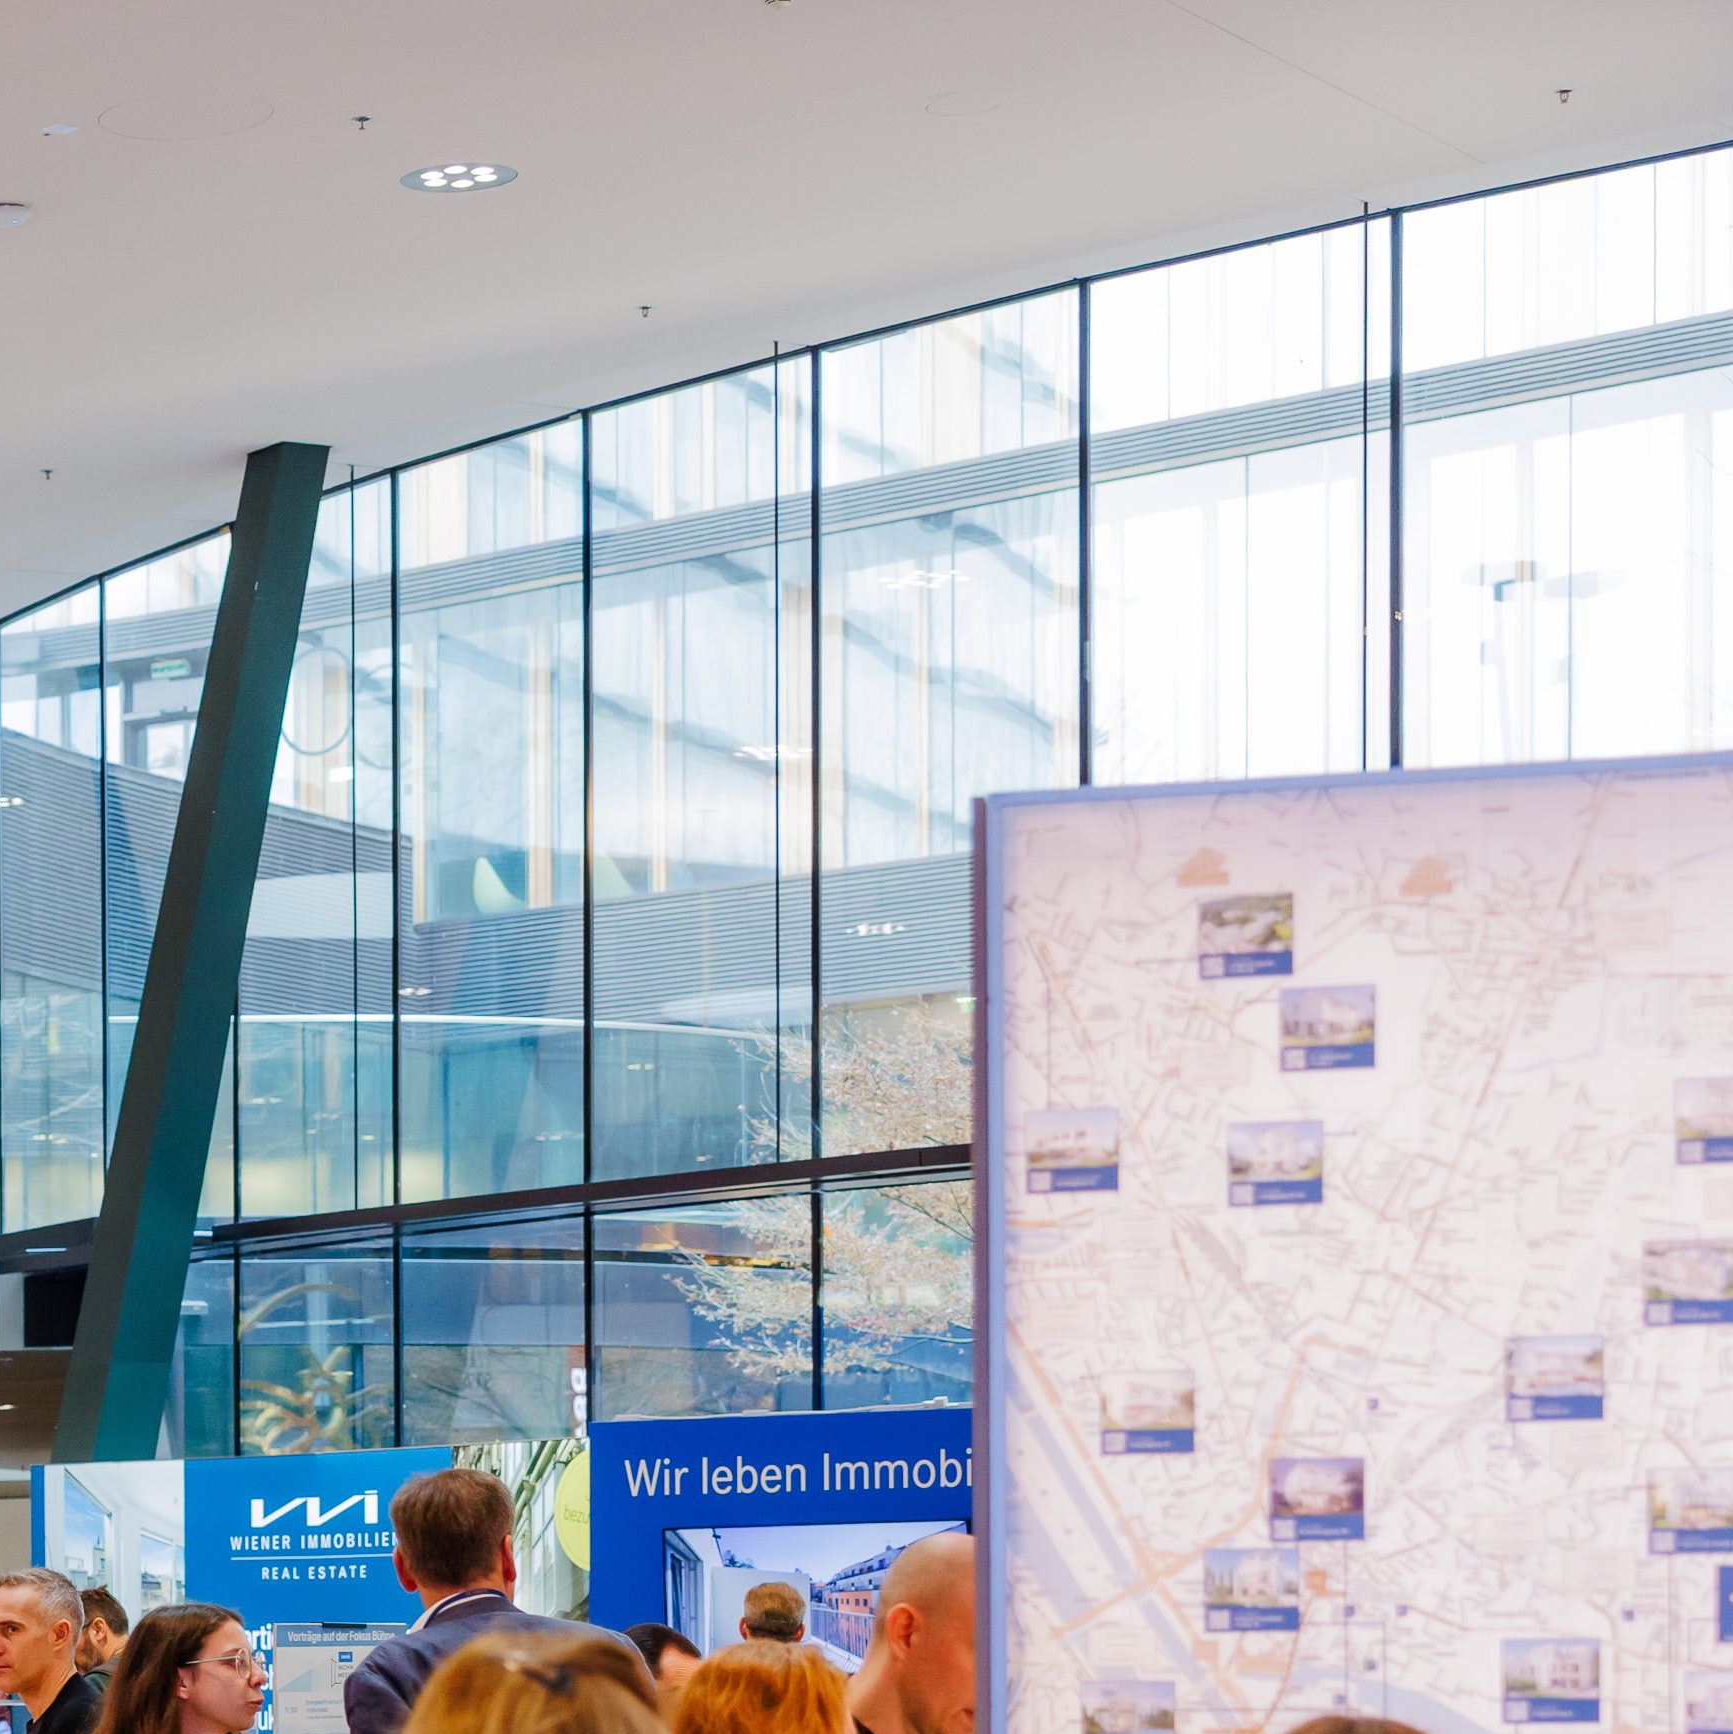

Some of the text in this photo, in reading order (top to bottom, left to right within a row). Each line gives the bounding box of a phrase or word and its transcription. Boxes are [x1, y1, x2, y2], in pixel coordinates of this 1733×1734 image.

[624, 1447, 973, 1497] Wir leben Immobi
[230, 1535, 291, 1551] WIENER
[261, 1565, 367, 1580] REAL ESTATE
[287, 1631, 321, 1644] Vorträge
[323, 1631, 334, 1641] auf
[336, 1631, 348, 1642] der
[349, 1631, 371, 1641] Fokus
